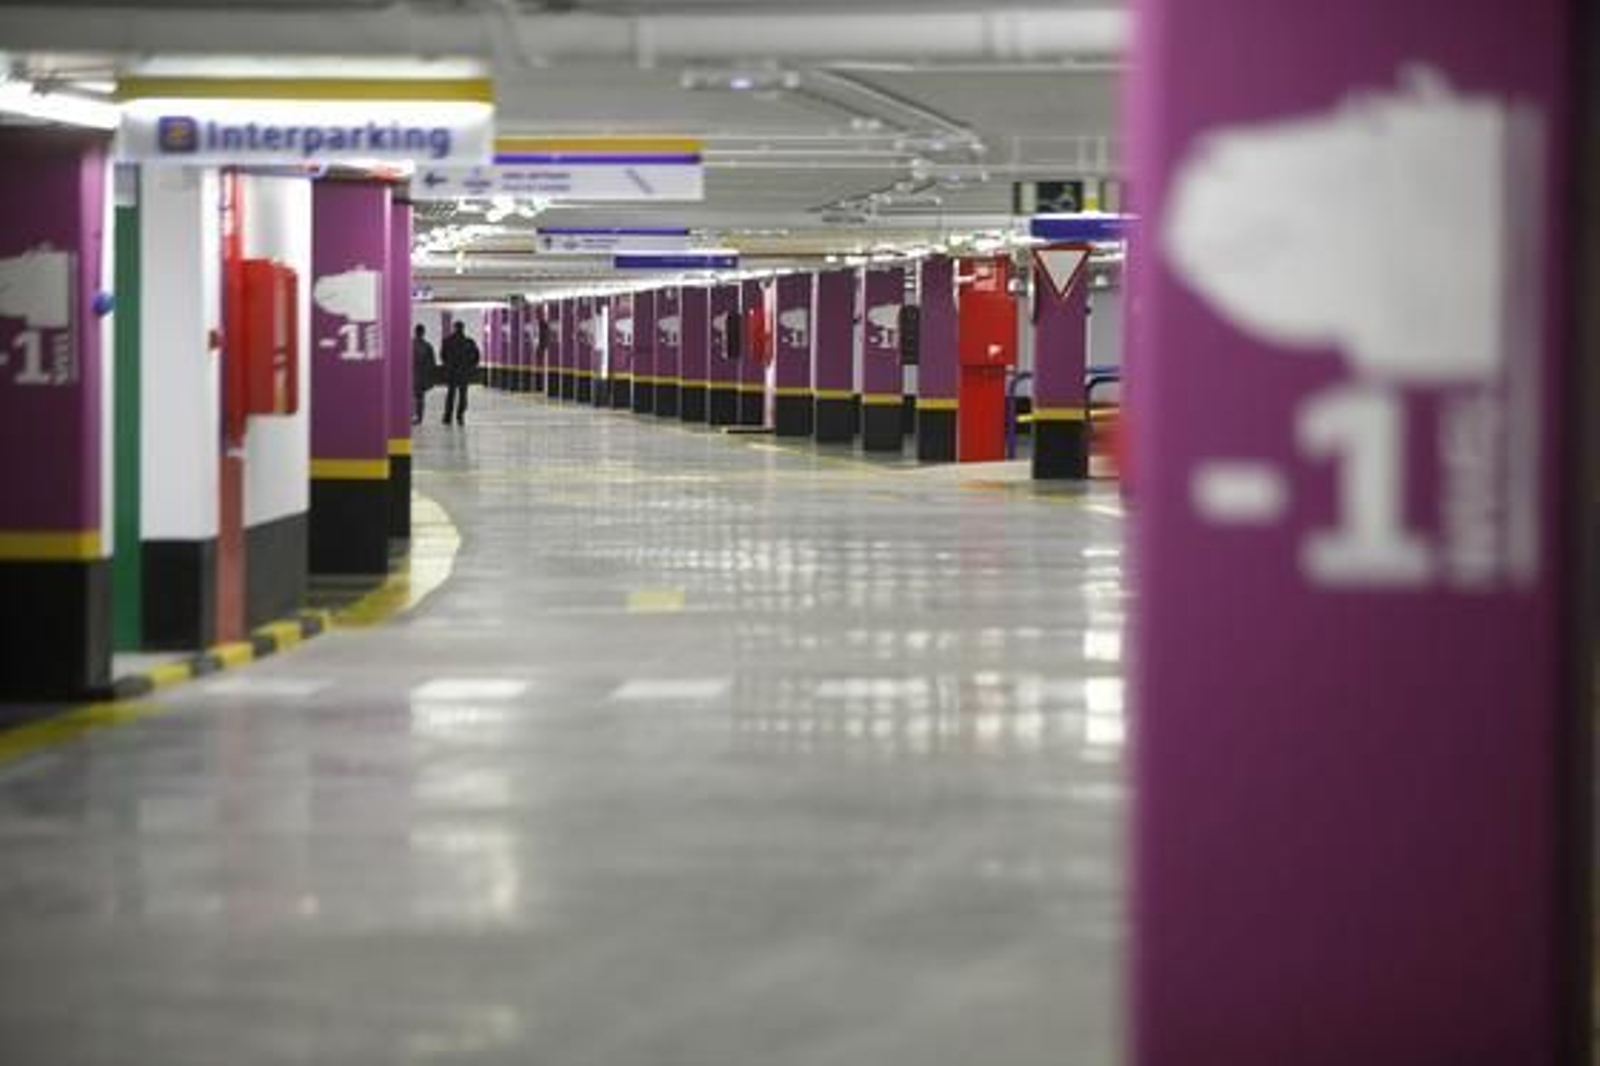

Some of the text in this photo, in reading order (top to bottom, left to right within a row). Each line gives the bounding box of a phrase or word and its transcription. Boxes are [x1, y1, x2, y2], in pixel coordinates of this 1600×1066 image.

[206, 120, 452, 159] Interparking
[318, 323, 366, 360] -1
[1191, 388, 1432, 588] -1
